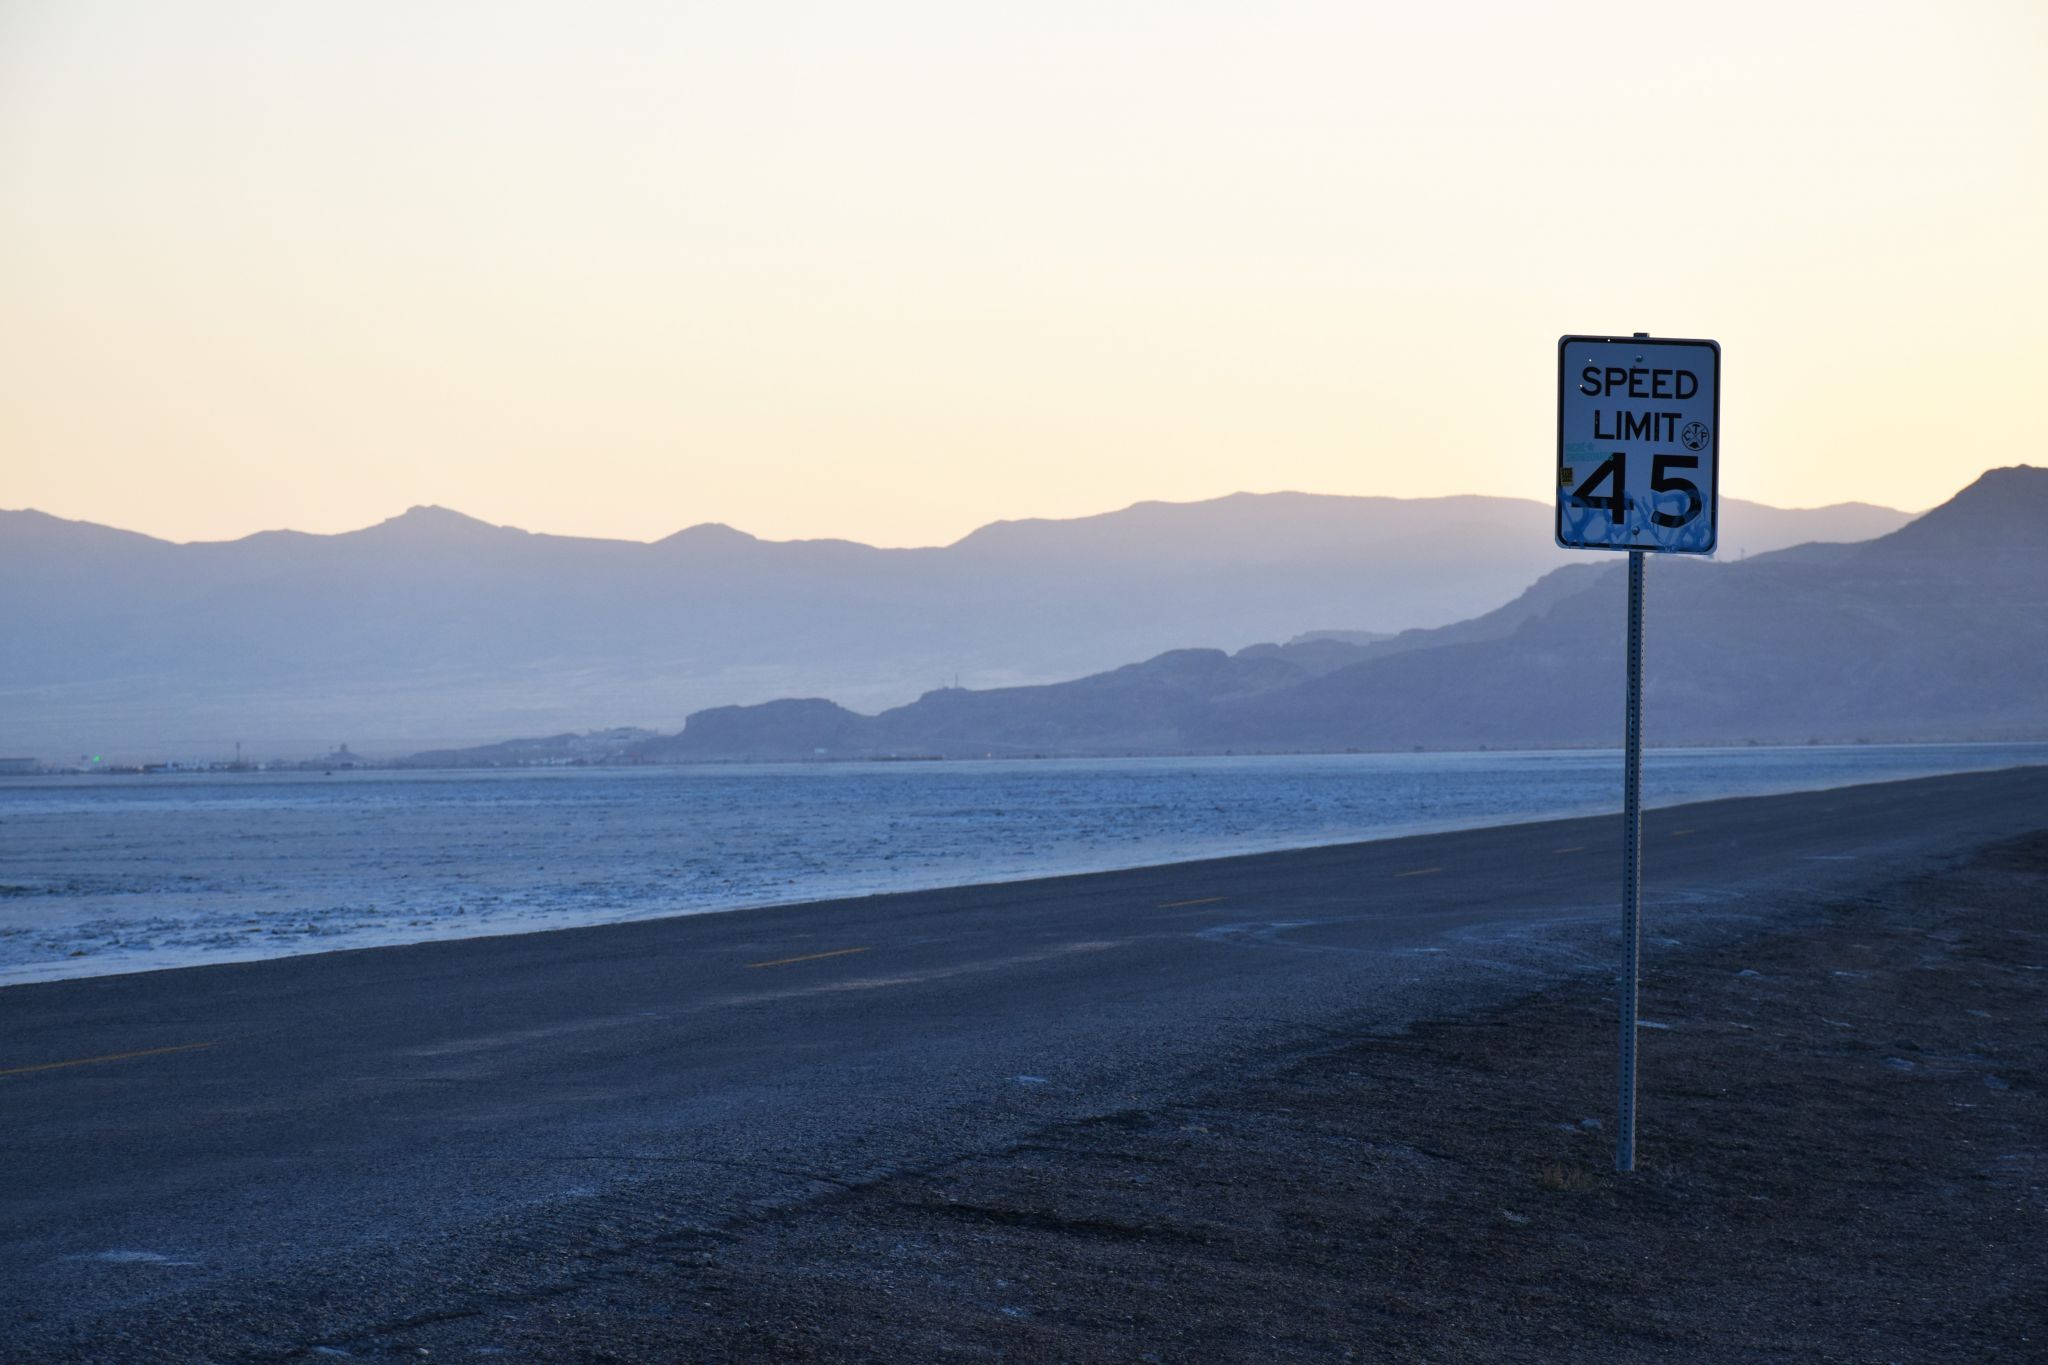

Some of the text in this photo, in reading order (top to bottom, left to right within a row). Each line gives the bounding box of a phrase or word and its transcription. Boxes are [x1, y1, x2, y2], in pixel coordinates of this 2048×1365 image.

[1580, 366, 1699, 400] SPEED
[1594, 410, 1682, 442] LIMIT
[1571, 452, 1703, 528] 45
